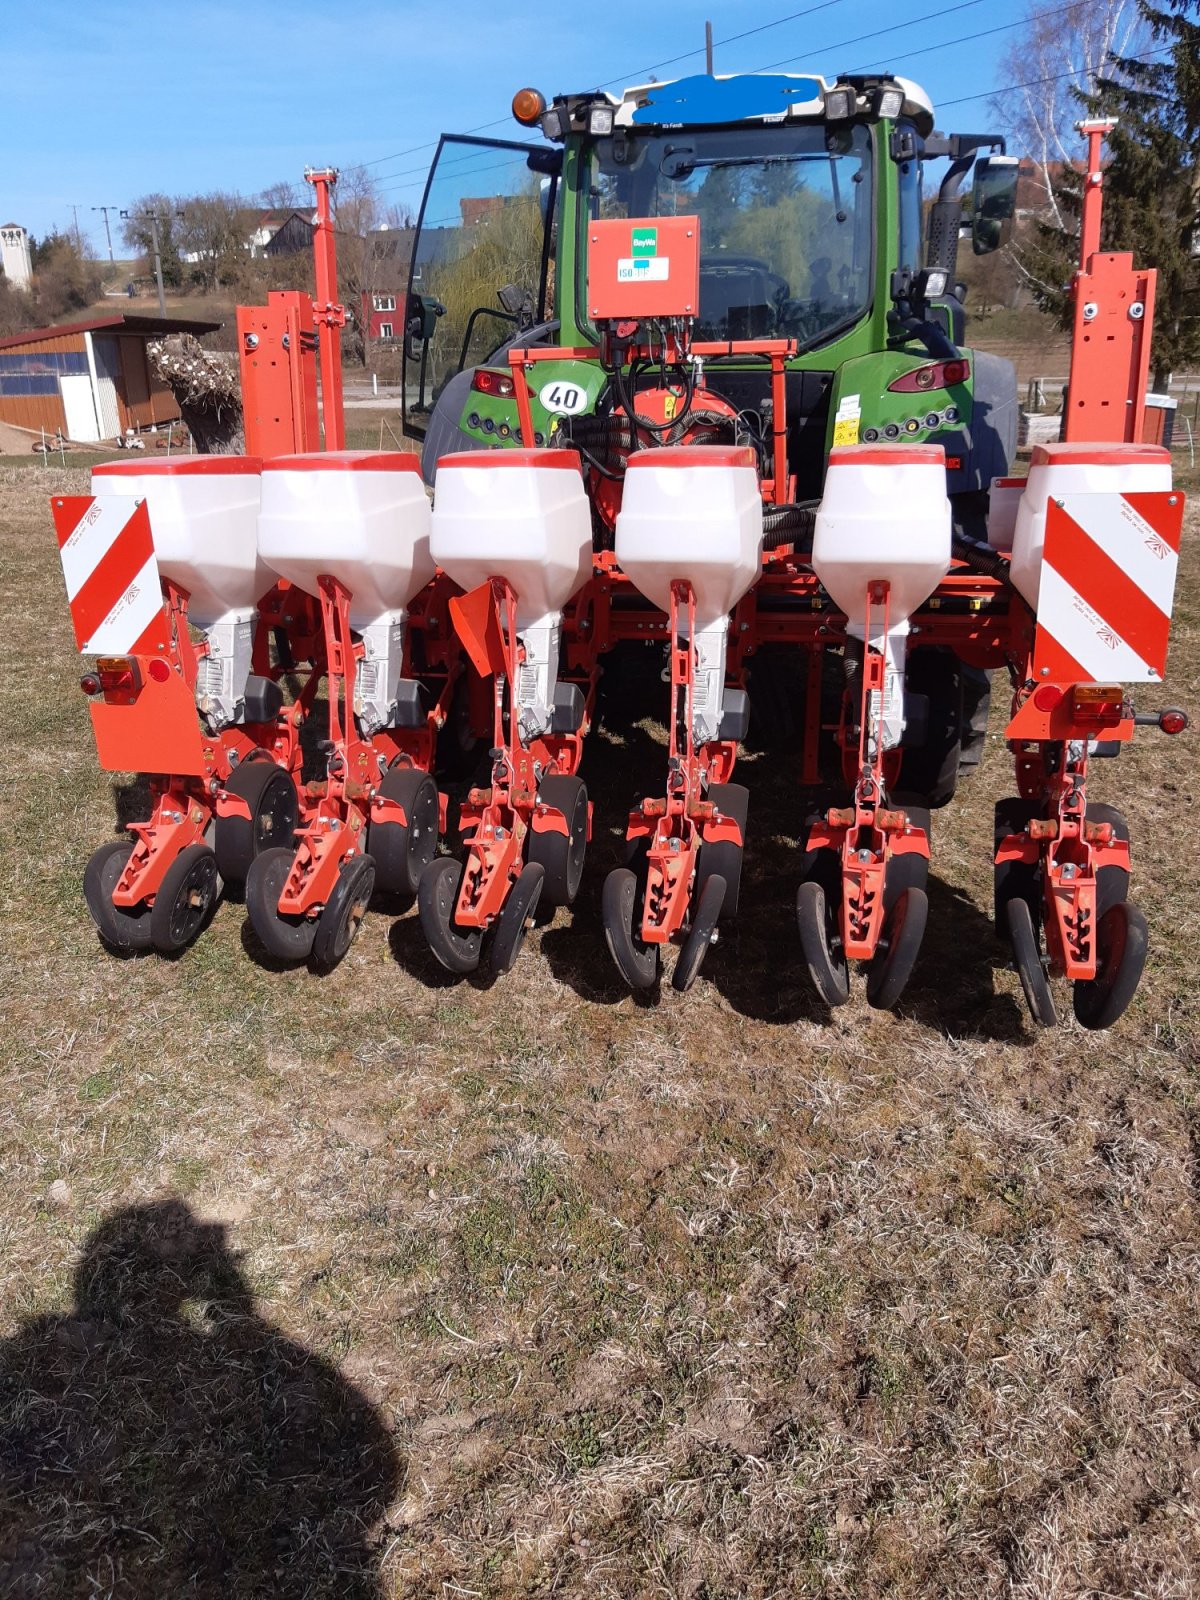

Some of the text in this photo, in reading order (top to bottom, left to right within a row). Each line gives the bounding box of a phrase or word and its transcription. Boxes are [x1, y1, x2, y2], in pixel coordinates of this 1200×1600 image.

[633, 238, 656, 248] BayWa
[619, 268, 633, 278] ISO
[549, 386, 578, 409] 40
